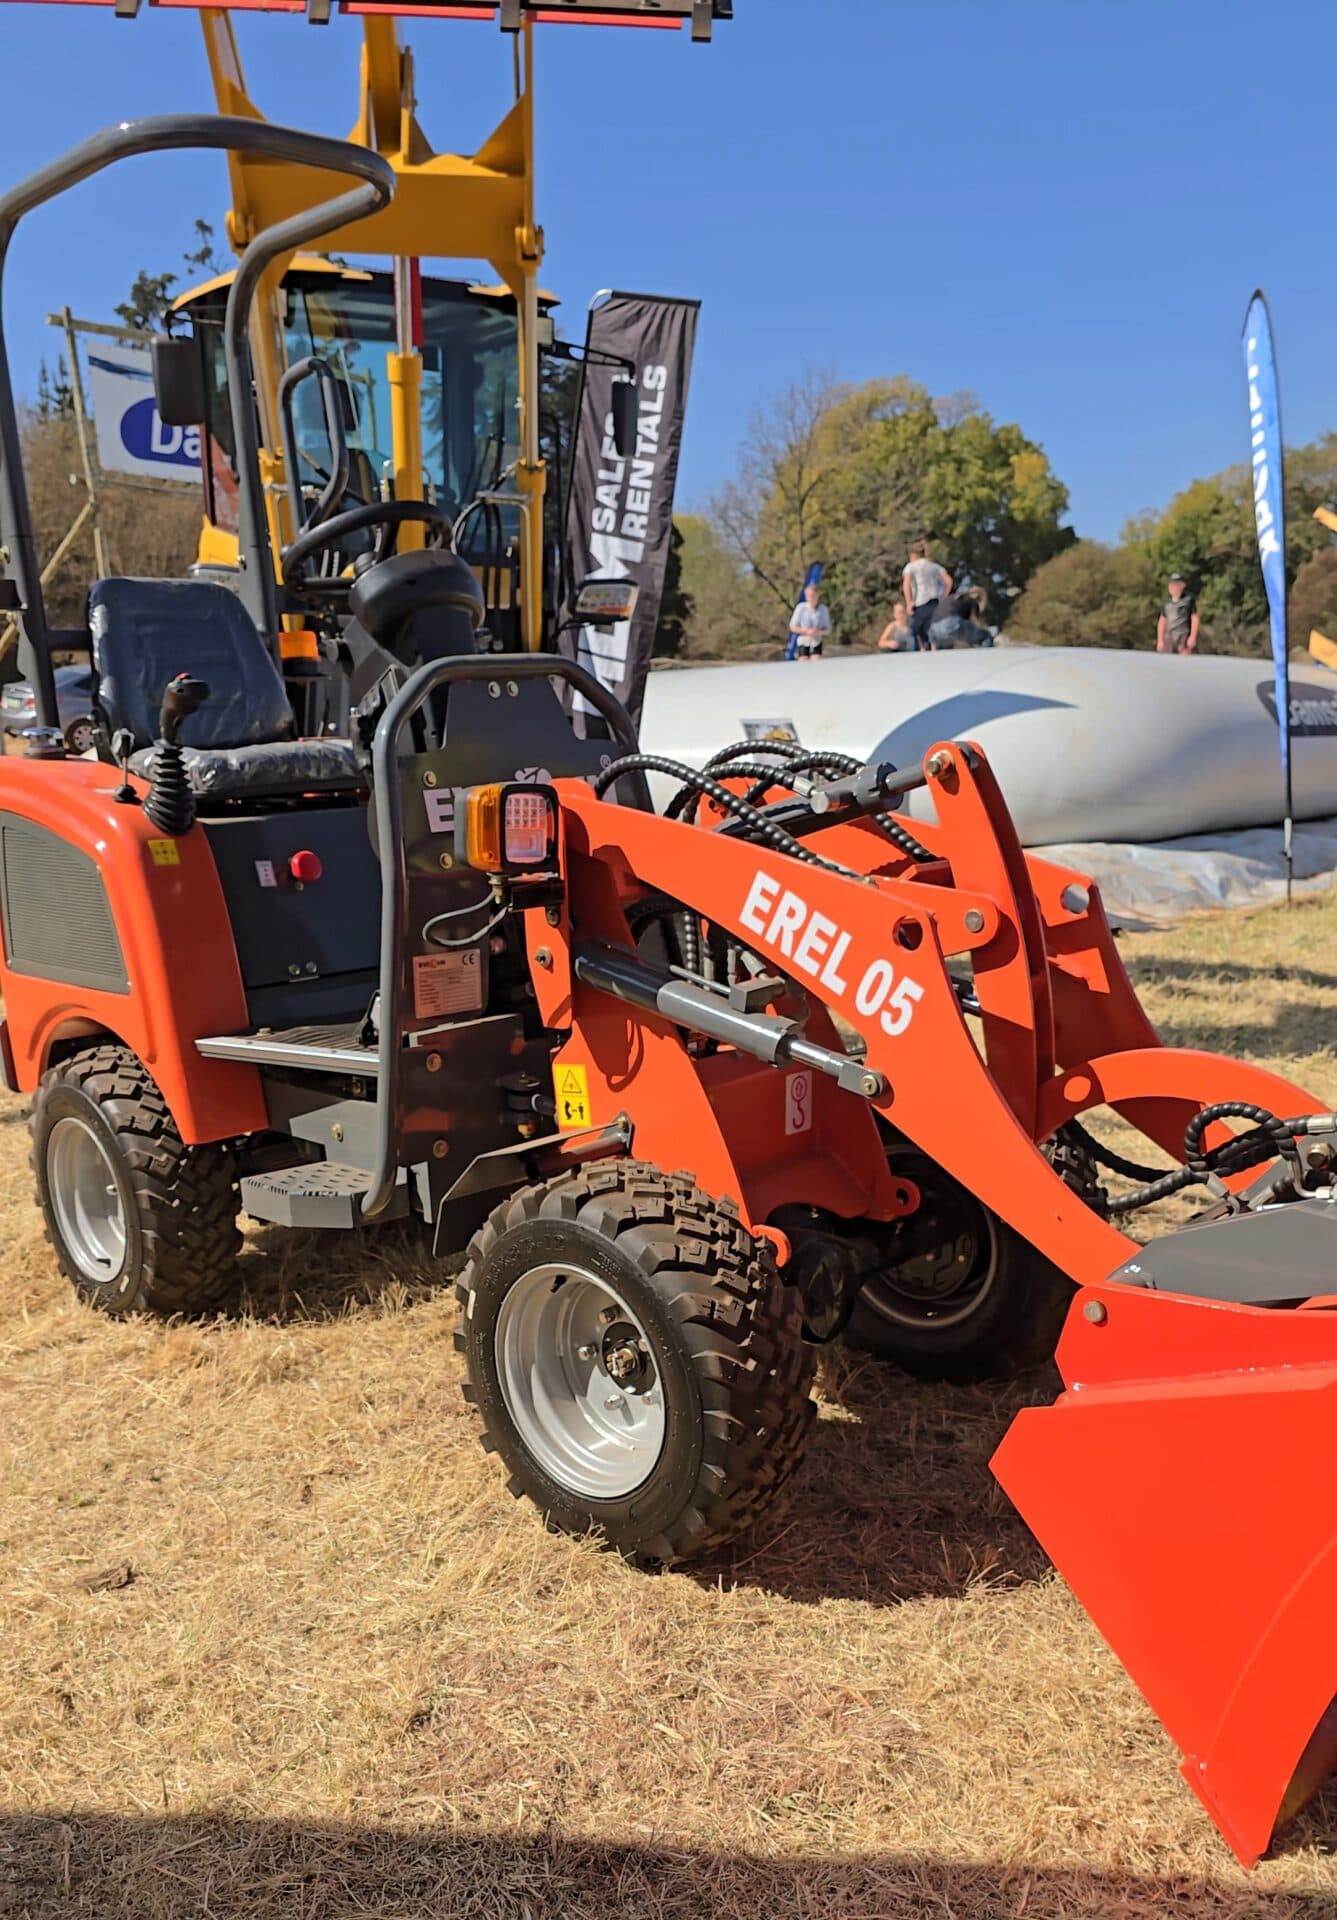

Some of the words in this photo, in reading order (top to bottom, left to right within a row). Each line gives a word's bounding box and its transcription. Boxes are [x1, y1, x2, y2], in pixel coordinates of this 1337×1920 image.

[620, 364, 668, 538] RENTALS
[739, 870, 852, 996] EREL
[855, 959, 925, 1036] 05
